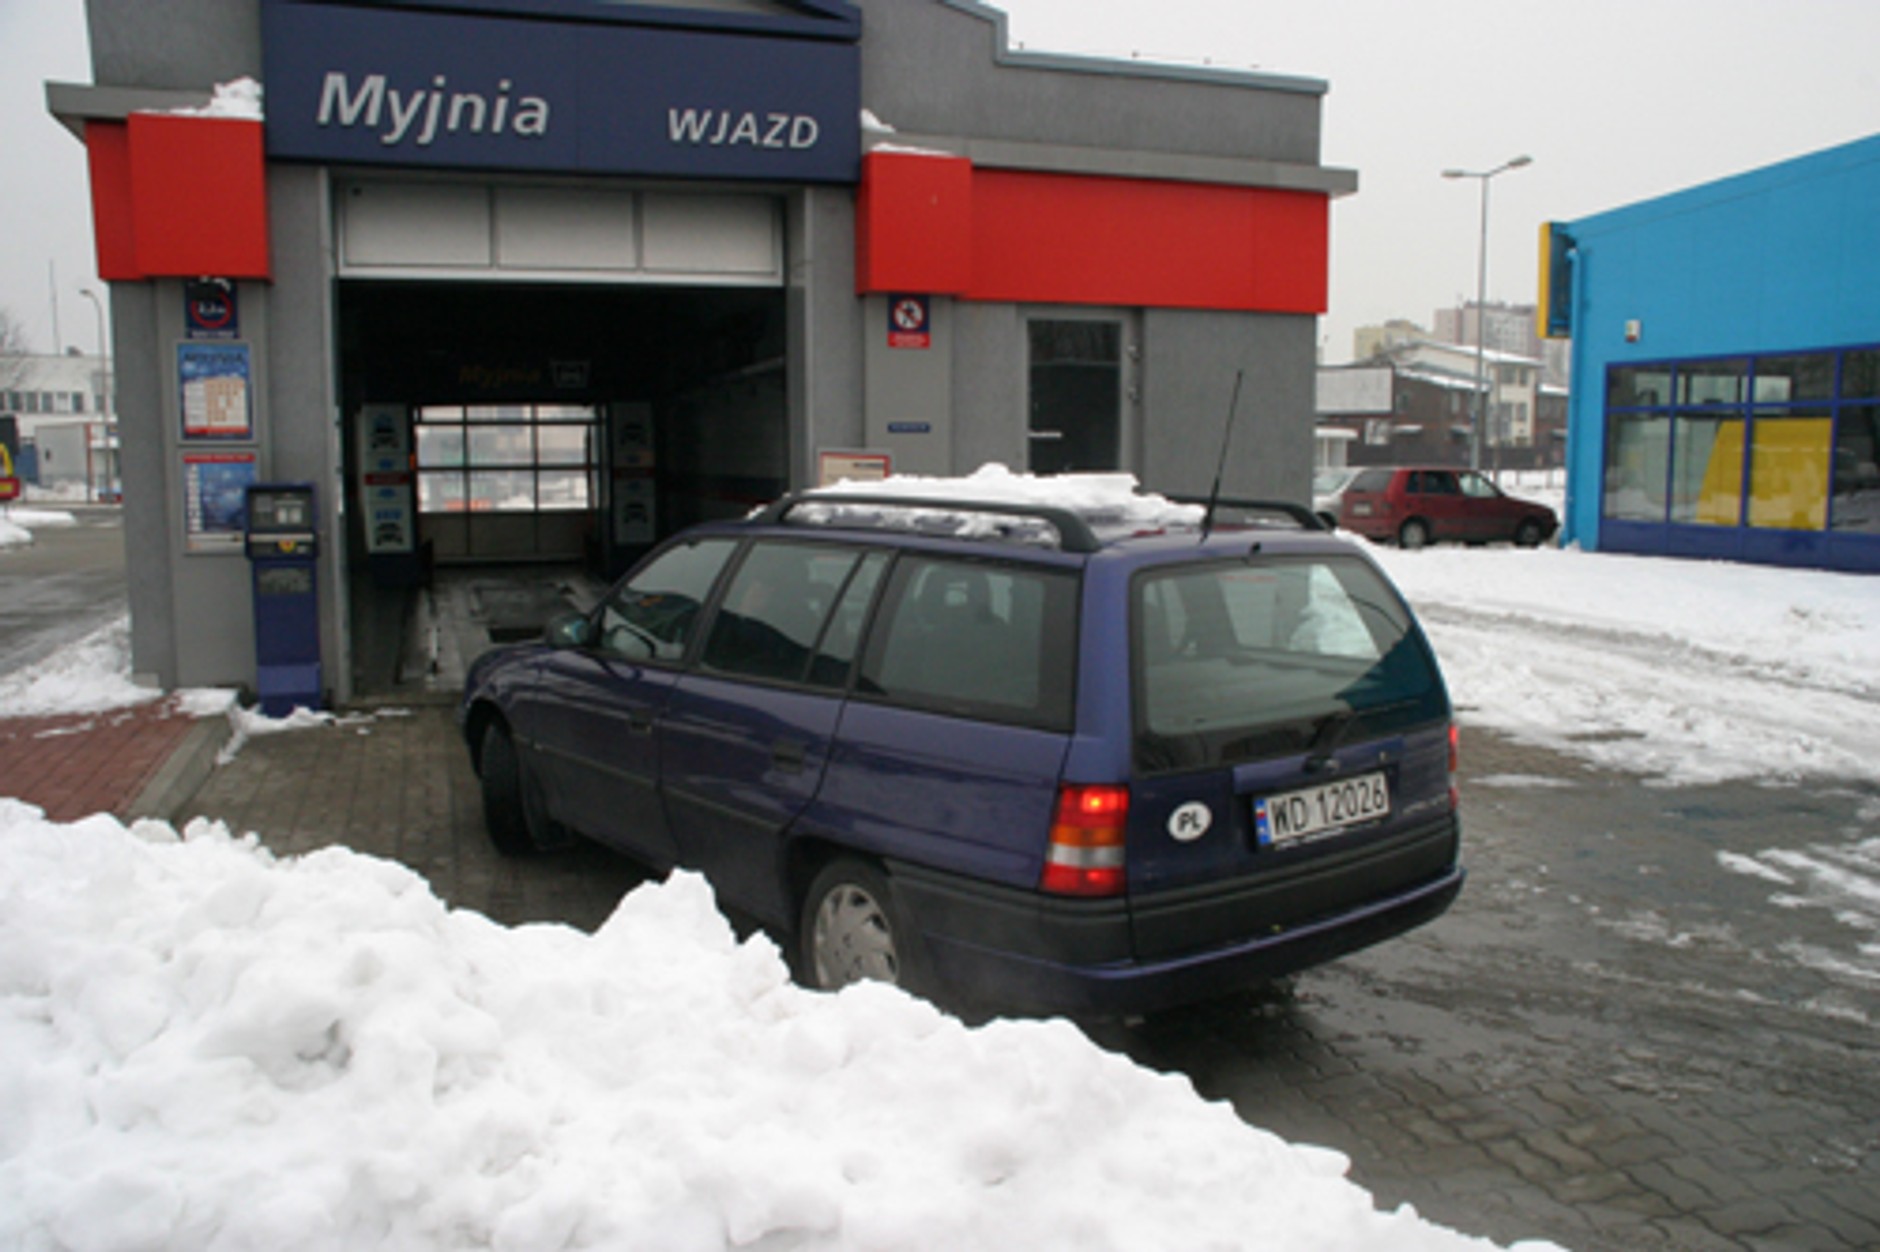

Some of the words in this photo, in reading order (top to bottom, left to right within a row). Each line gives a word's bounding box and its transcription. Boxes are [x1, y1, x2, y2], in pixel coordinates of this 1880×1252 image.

[317, 72, 549, 145] Myjnia
[669, 108, 819, 149] WJAZD
[1176, 810, 1202, 833] PL
[1270, 797, 1308, 834] WD
[1316, 778, 1385, 825] 12026
